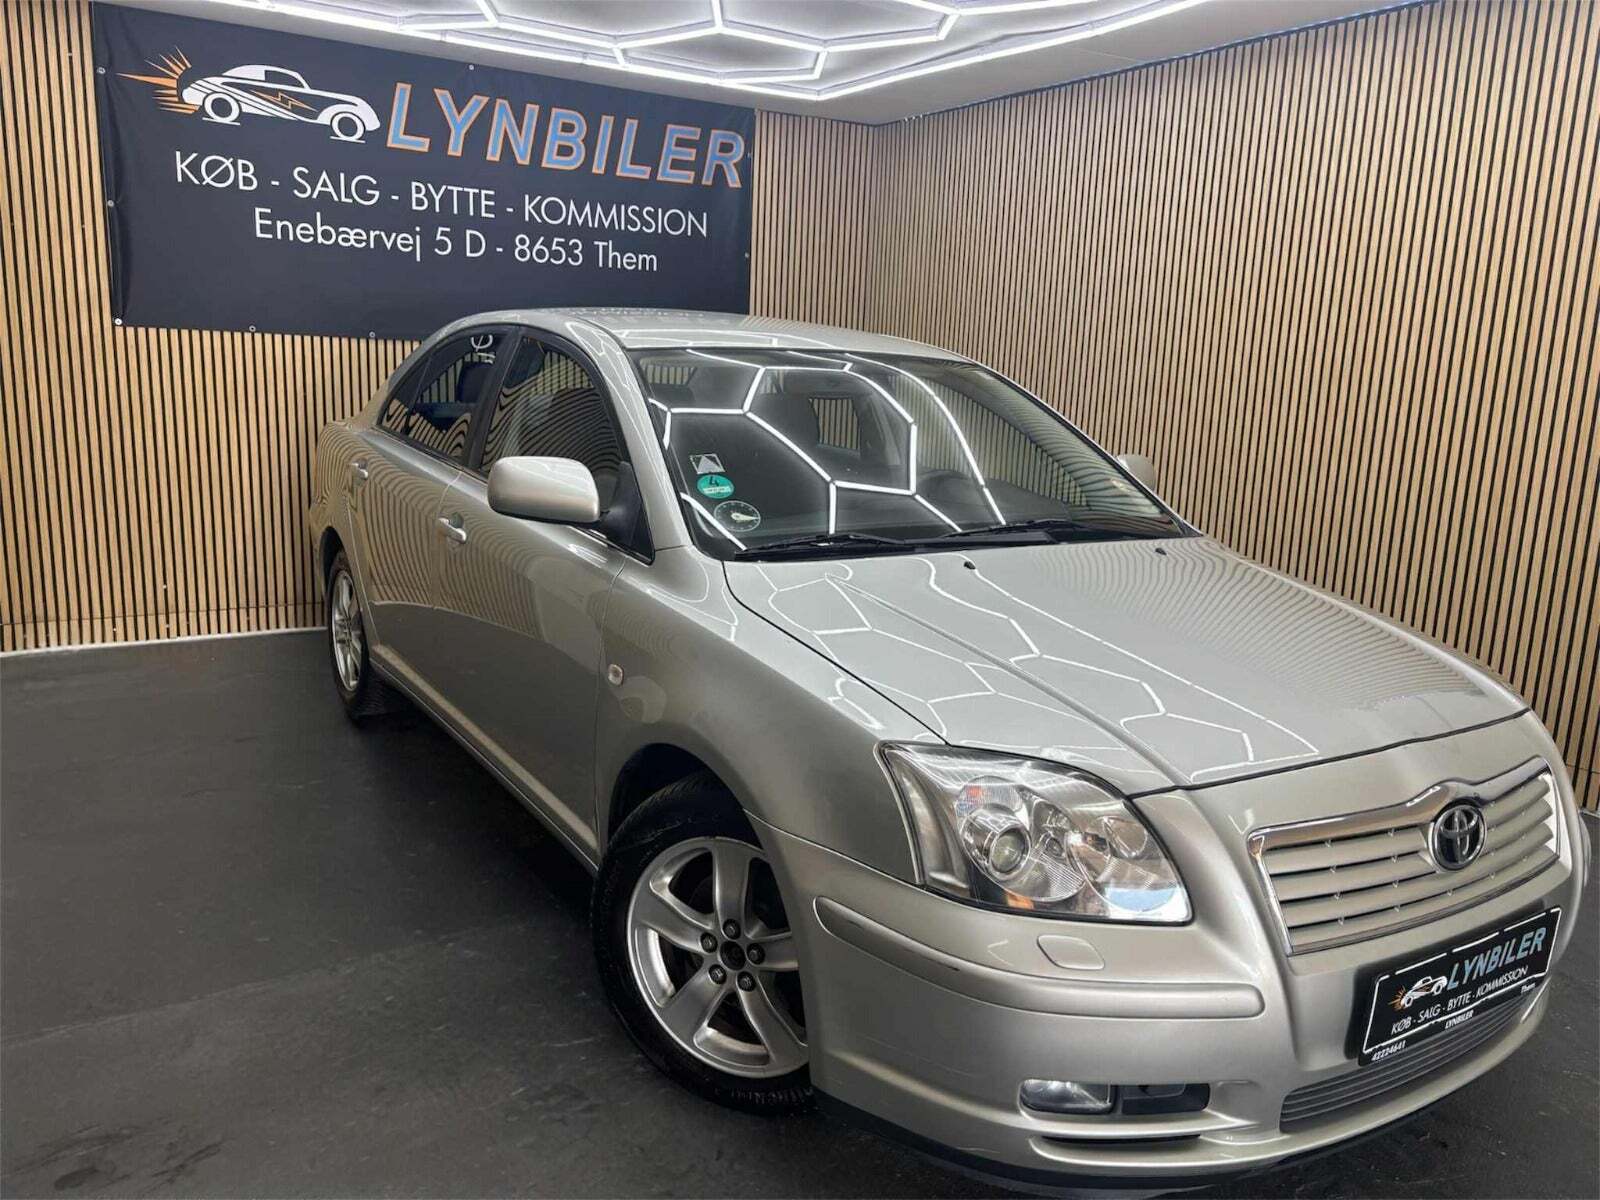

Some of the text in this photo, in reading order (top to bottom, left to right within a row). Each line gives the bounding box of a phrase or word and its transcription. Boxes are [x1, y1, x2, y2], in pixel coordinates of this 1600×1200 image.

[386, 82, 745, 188] LYNBILER
[175, 151, 258, 191] KØB
[293, 166, 380, 206] SALG
[411, 181, 496, 219] BYTTE
[524, 194, 708, 238] KOMMISSION
[254, 207, 422, 262] Enebærvej
[434, 227, 452, 256] 5
[466, 229, 486, 257] D
[514, 234, 583, 266] 8653
[593, 240, 657, 271] Them
[1447, 927, 1546, 991] LYNBILER
[1391, 1016, 1411, 1036] KØB
[1417, 1003, 1441, 1022] SALG
[1447, 992, 1471, 1011] BYTTE
[1475, 965, 1529, 998] KOMMISSION
[1445, 1009, 1474, 1030] LYNBILER
